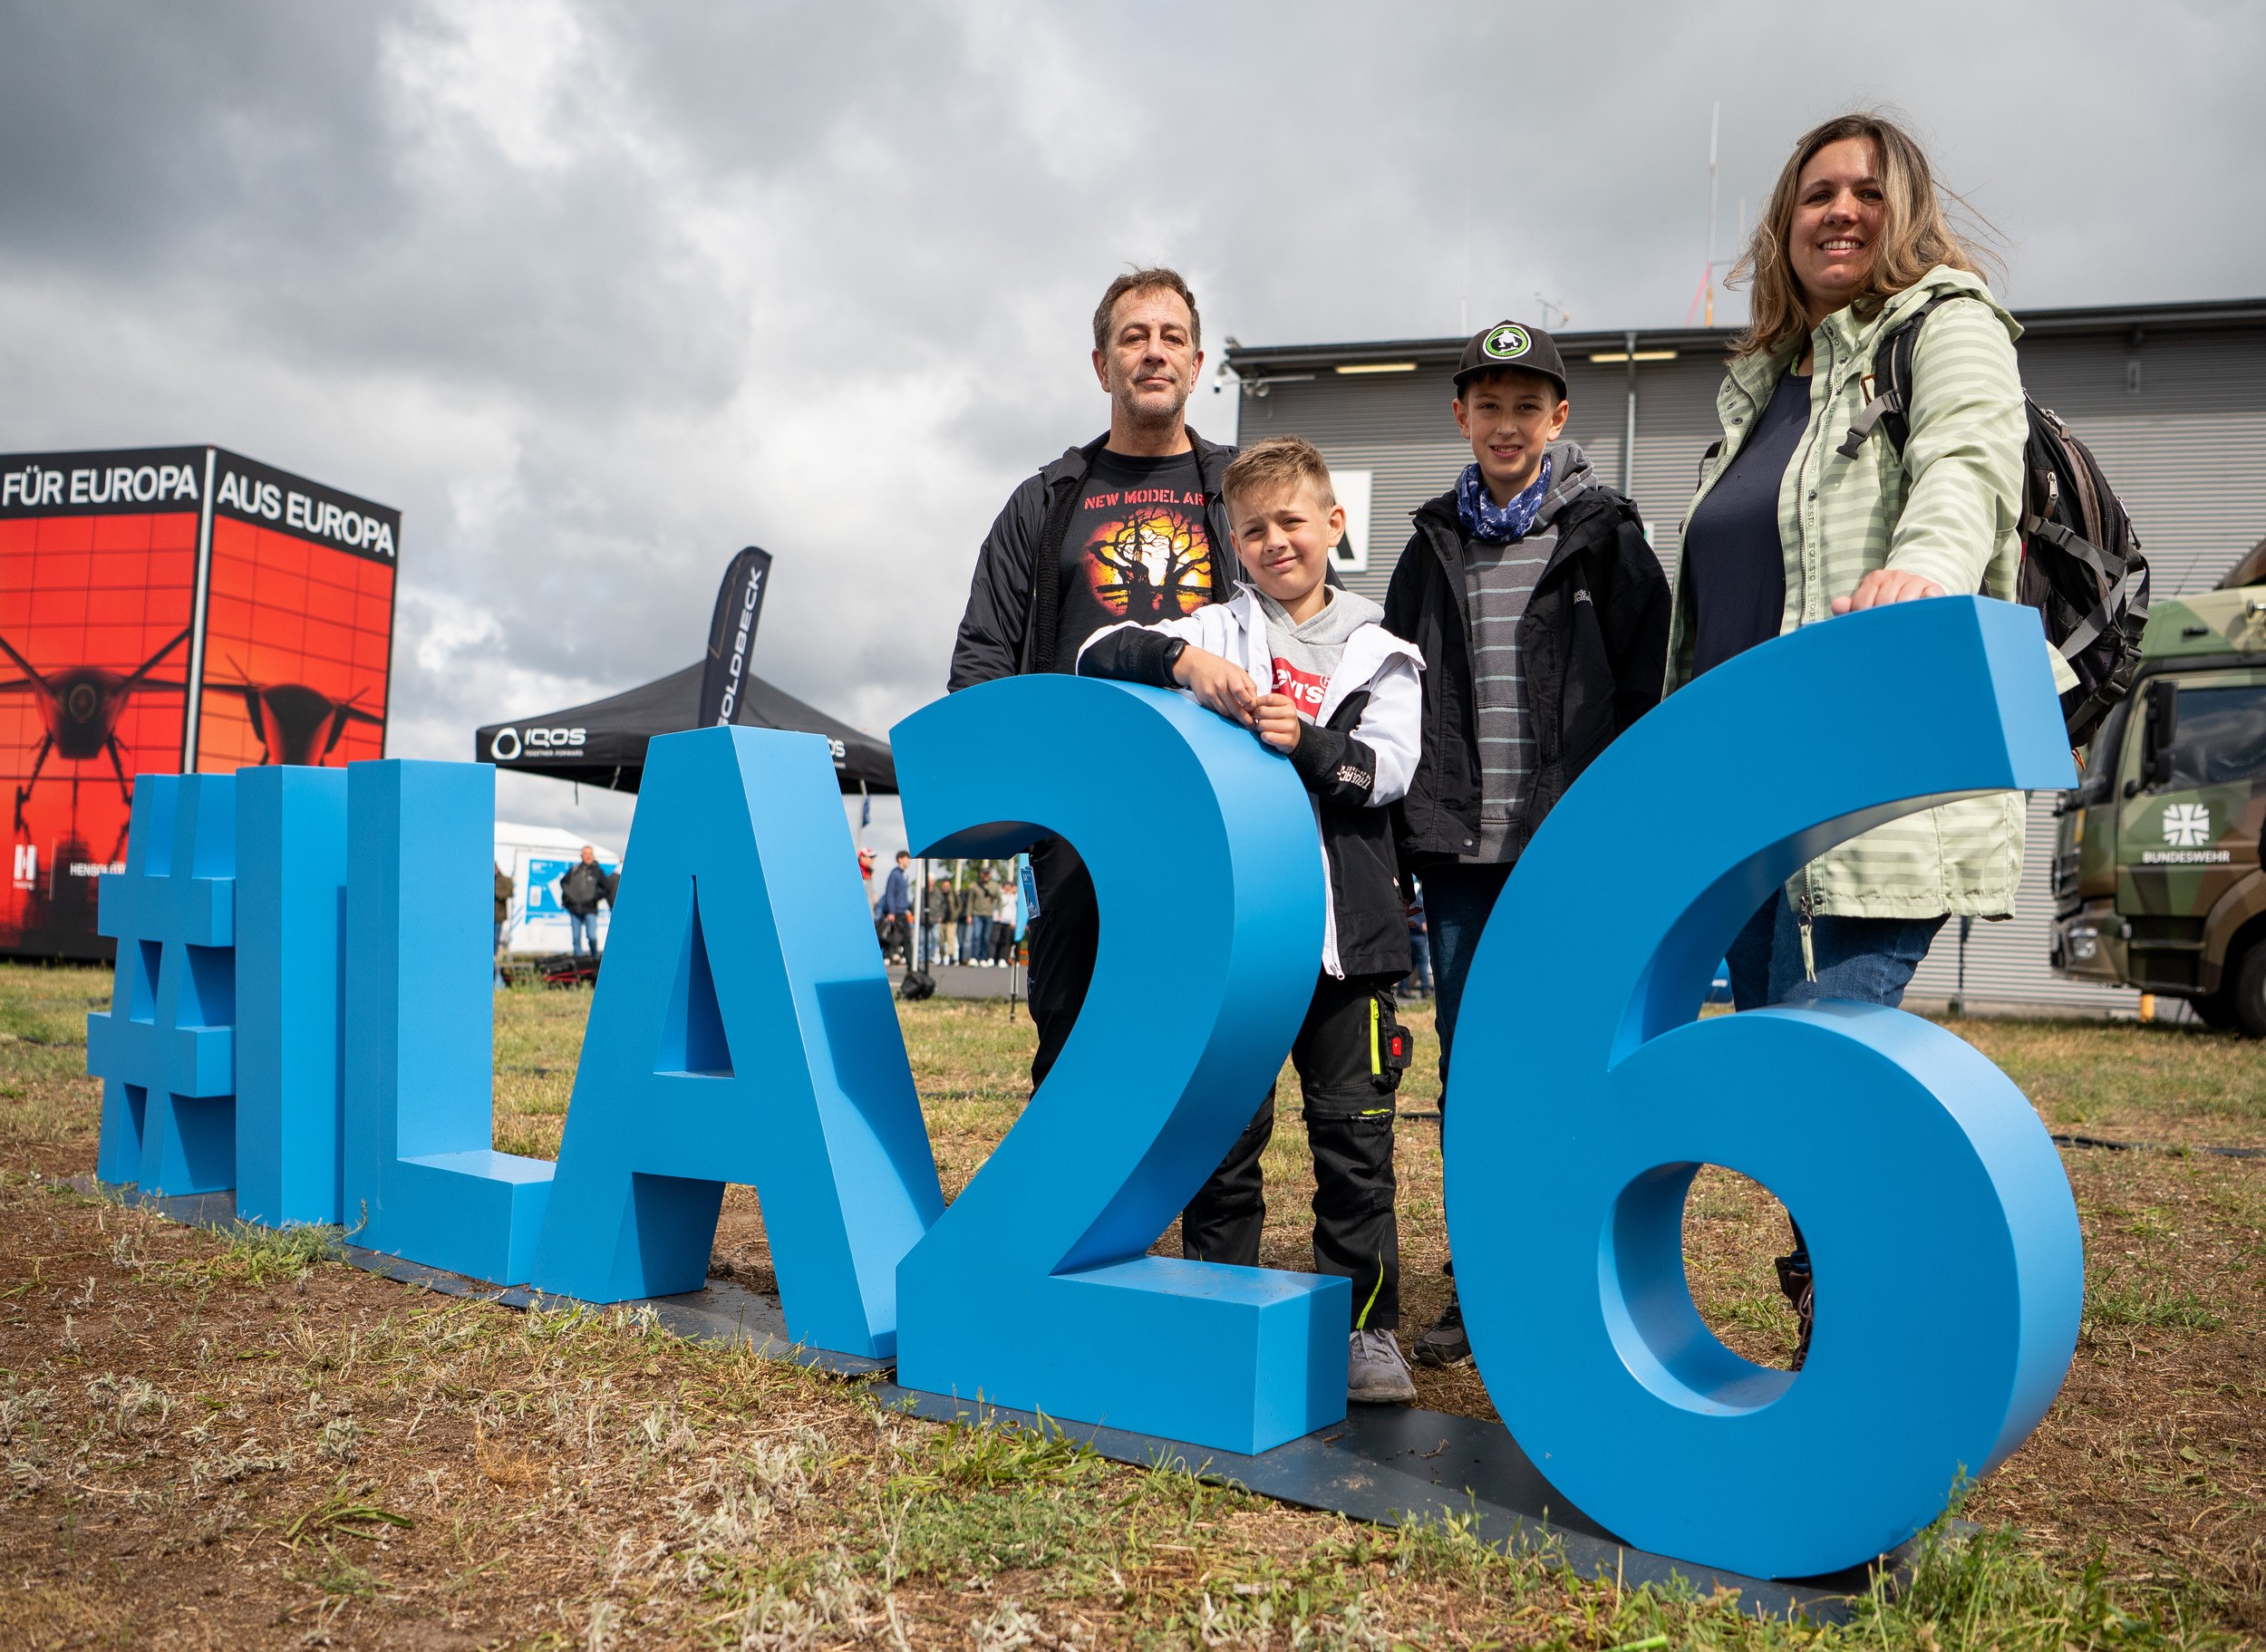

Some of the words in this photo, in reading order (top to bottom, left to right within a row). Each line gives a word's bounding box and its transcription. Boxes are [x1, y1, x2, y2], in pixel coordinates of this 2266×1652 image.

[2, 466, 63, 506] FÜR
[70, 465, 199, 504] EUROPA
[1084, 492, 1120, 510] NEW
[1124, 489, 1179, 504] MODEL
[1183, 492, 1205, 506] AR
[217, 471, 282, 520] AUS
[286, 491, 395, 557] EUROPA
[1272, 669, 1325, 703] evi's
[524, 728, 587, 749] IQOS
[2142, 850, 2231, 864] BUNDESWEHR
